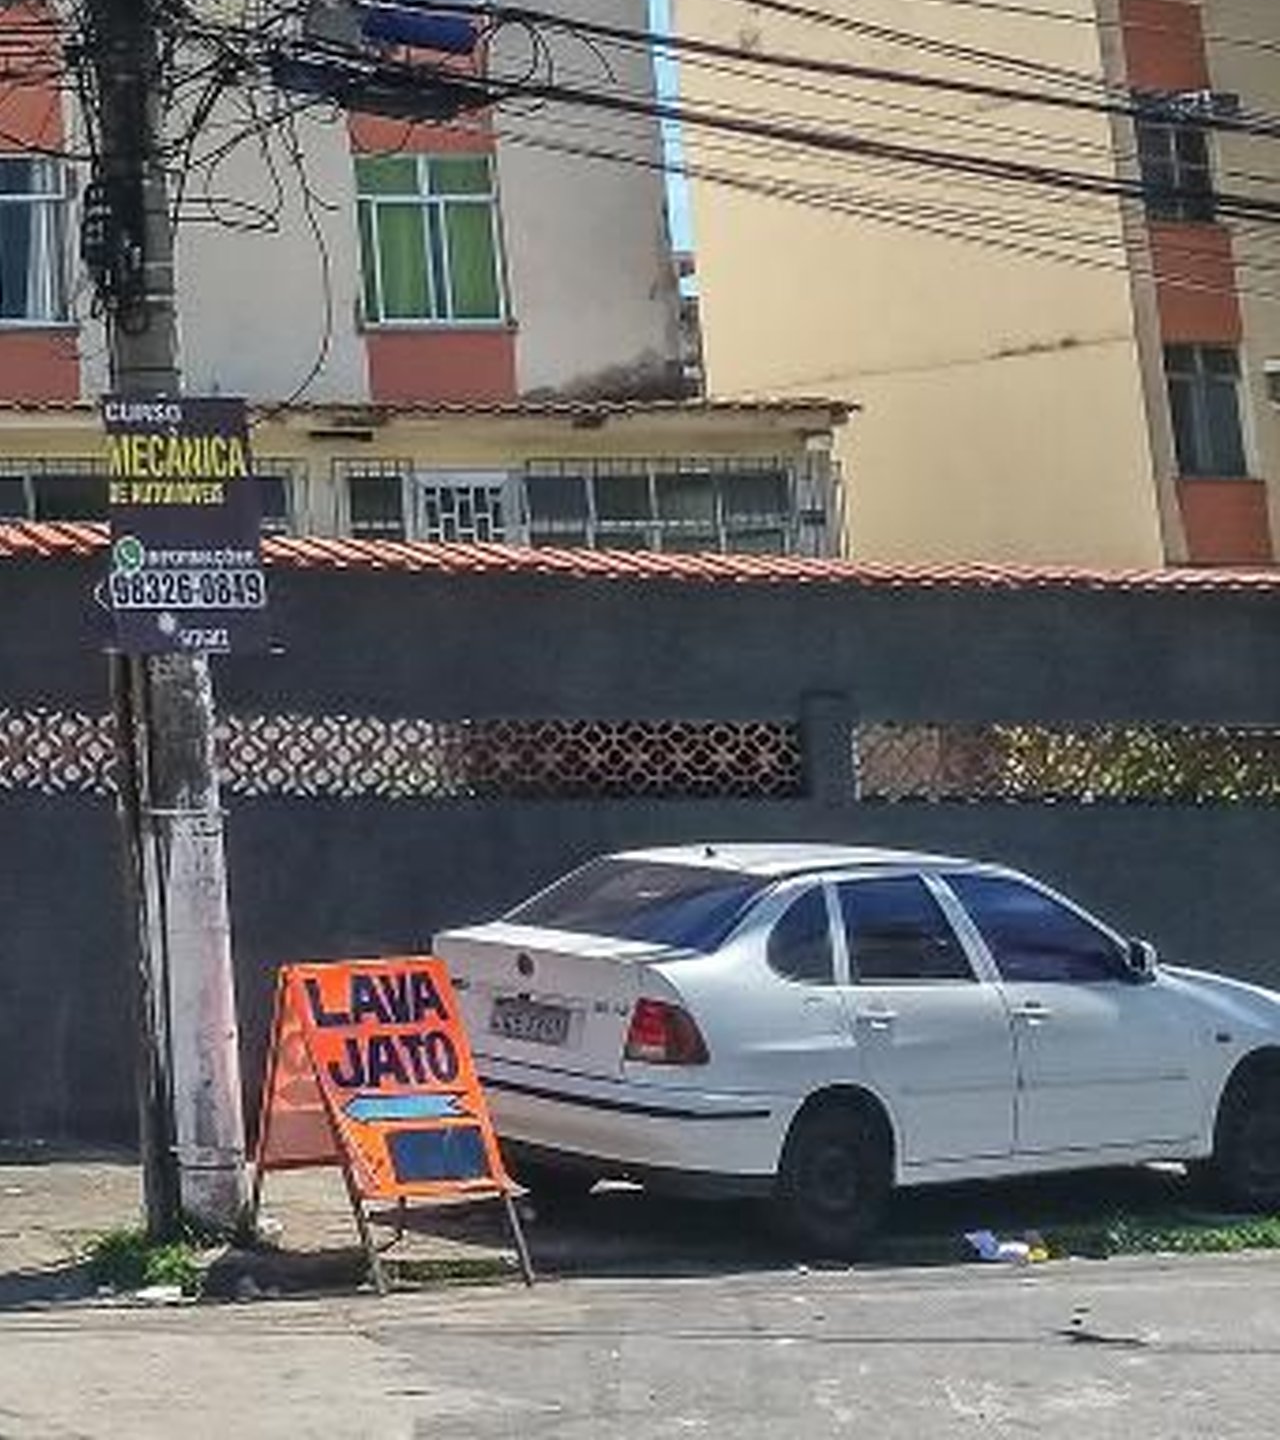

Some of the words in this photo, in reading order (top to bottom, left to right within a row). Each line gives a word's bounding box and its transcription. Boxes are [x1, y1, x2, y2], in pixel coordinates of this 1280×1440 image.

[105, 403, 182, 422] CURSO
[306, 971, 448, 1026] LAVA
[328, 1031, 458, 1087] JATO
